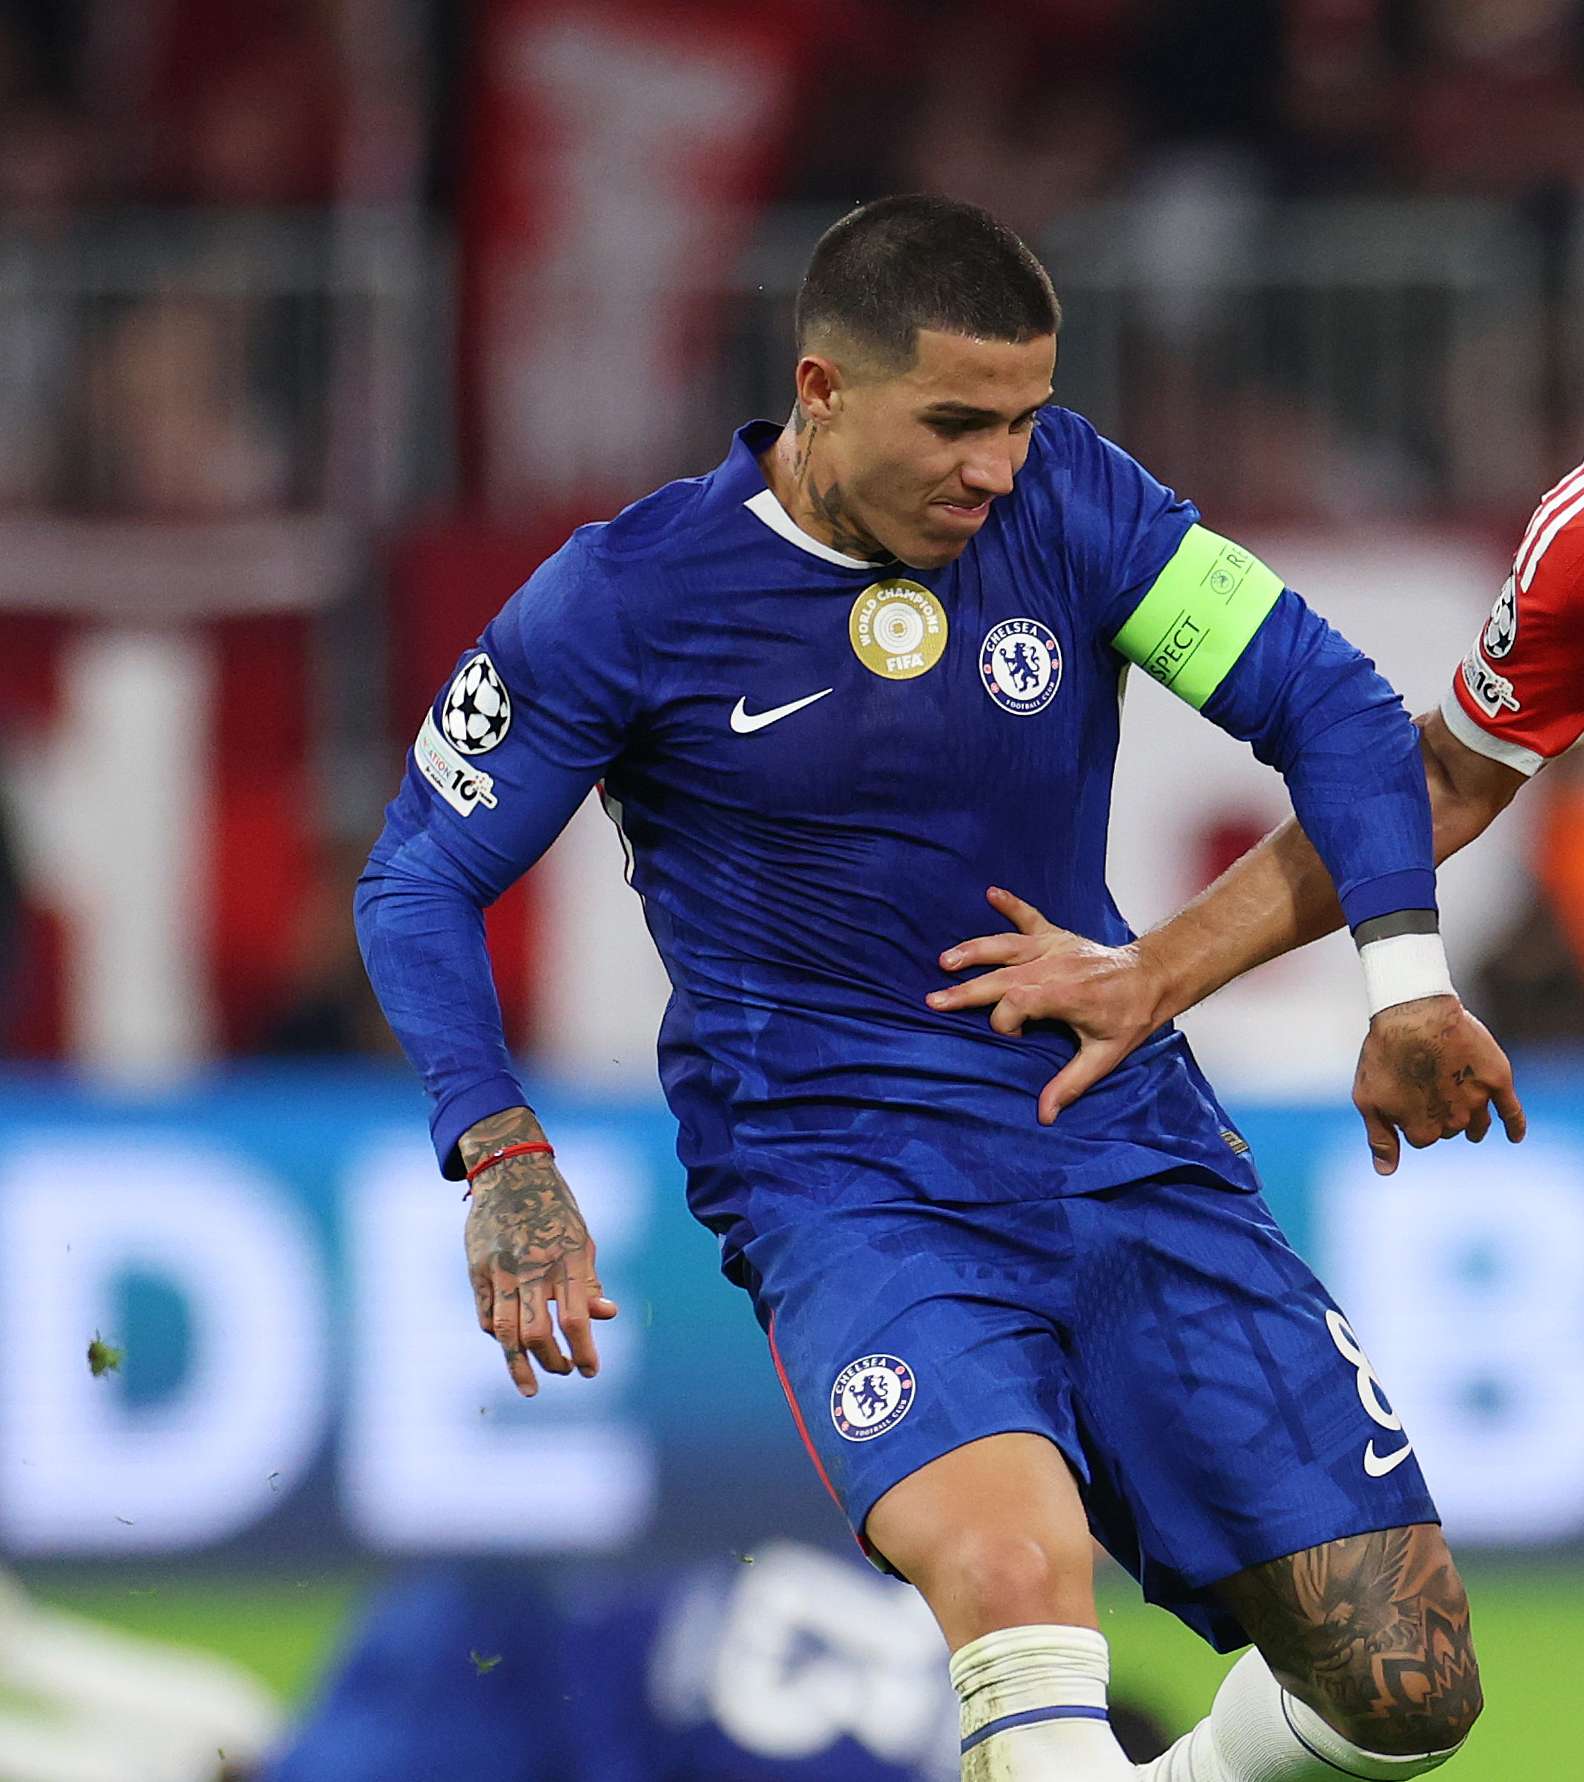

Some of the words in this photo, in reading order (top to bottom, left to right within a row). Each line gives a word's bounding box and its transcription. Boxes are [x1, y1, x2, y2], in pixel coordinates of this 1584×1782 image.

[858, 599, 877, 647] WORLD
[876, 587, 939, 634] CHAMPIONS
[986, 622, 1038, 652] CHELSEA
[886, 652, 925, 673] FIFA
[835, 1357, 887, 1394] CHELSEA
[1325, 1309, 1402, 1431] 8
[892, 1399, 907, 1418] CLUB
